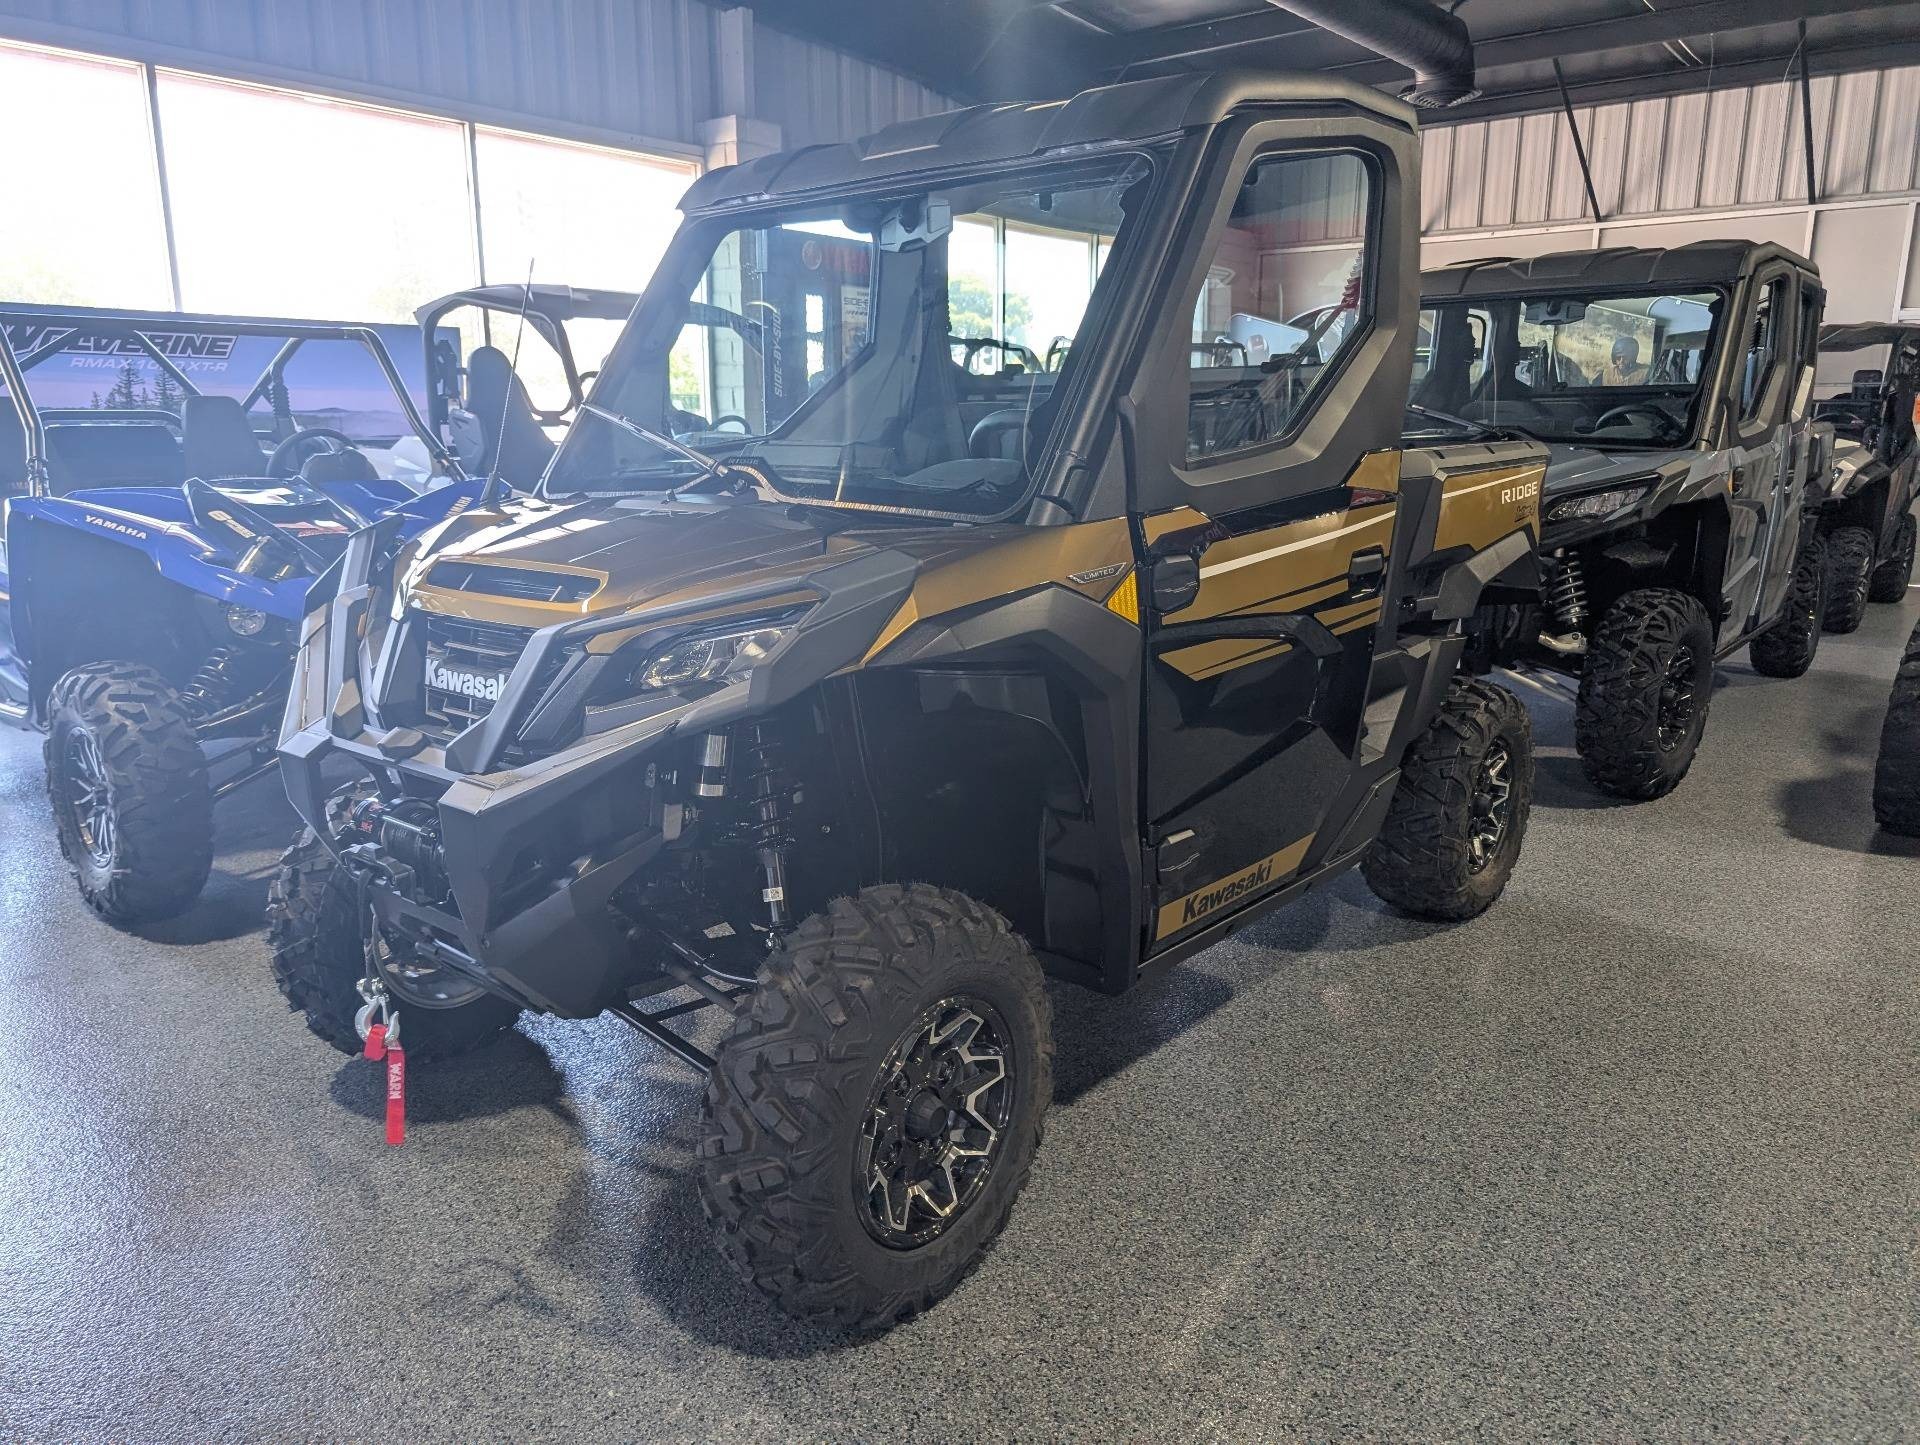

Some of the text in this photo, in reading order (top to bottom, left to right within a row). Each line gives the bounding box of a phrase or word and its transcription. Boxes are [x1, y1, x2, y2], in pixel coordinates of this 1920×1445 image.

[70, 357, 131, 369] RMAX
[137, 359, 184, 372] 100
[1501, 481, 1538, 505] RIDGE
[84, 514, 147, 540] YAMAHA
[1084, 568, 1115, 580] LIMITED
[425, 658, 508, 701] Kawasak
[1182, 858, 1273, 924] Kawasaki
[389, 1062, 402, 1100] WARN
